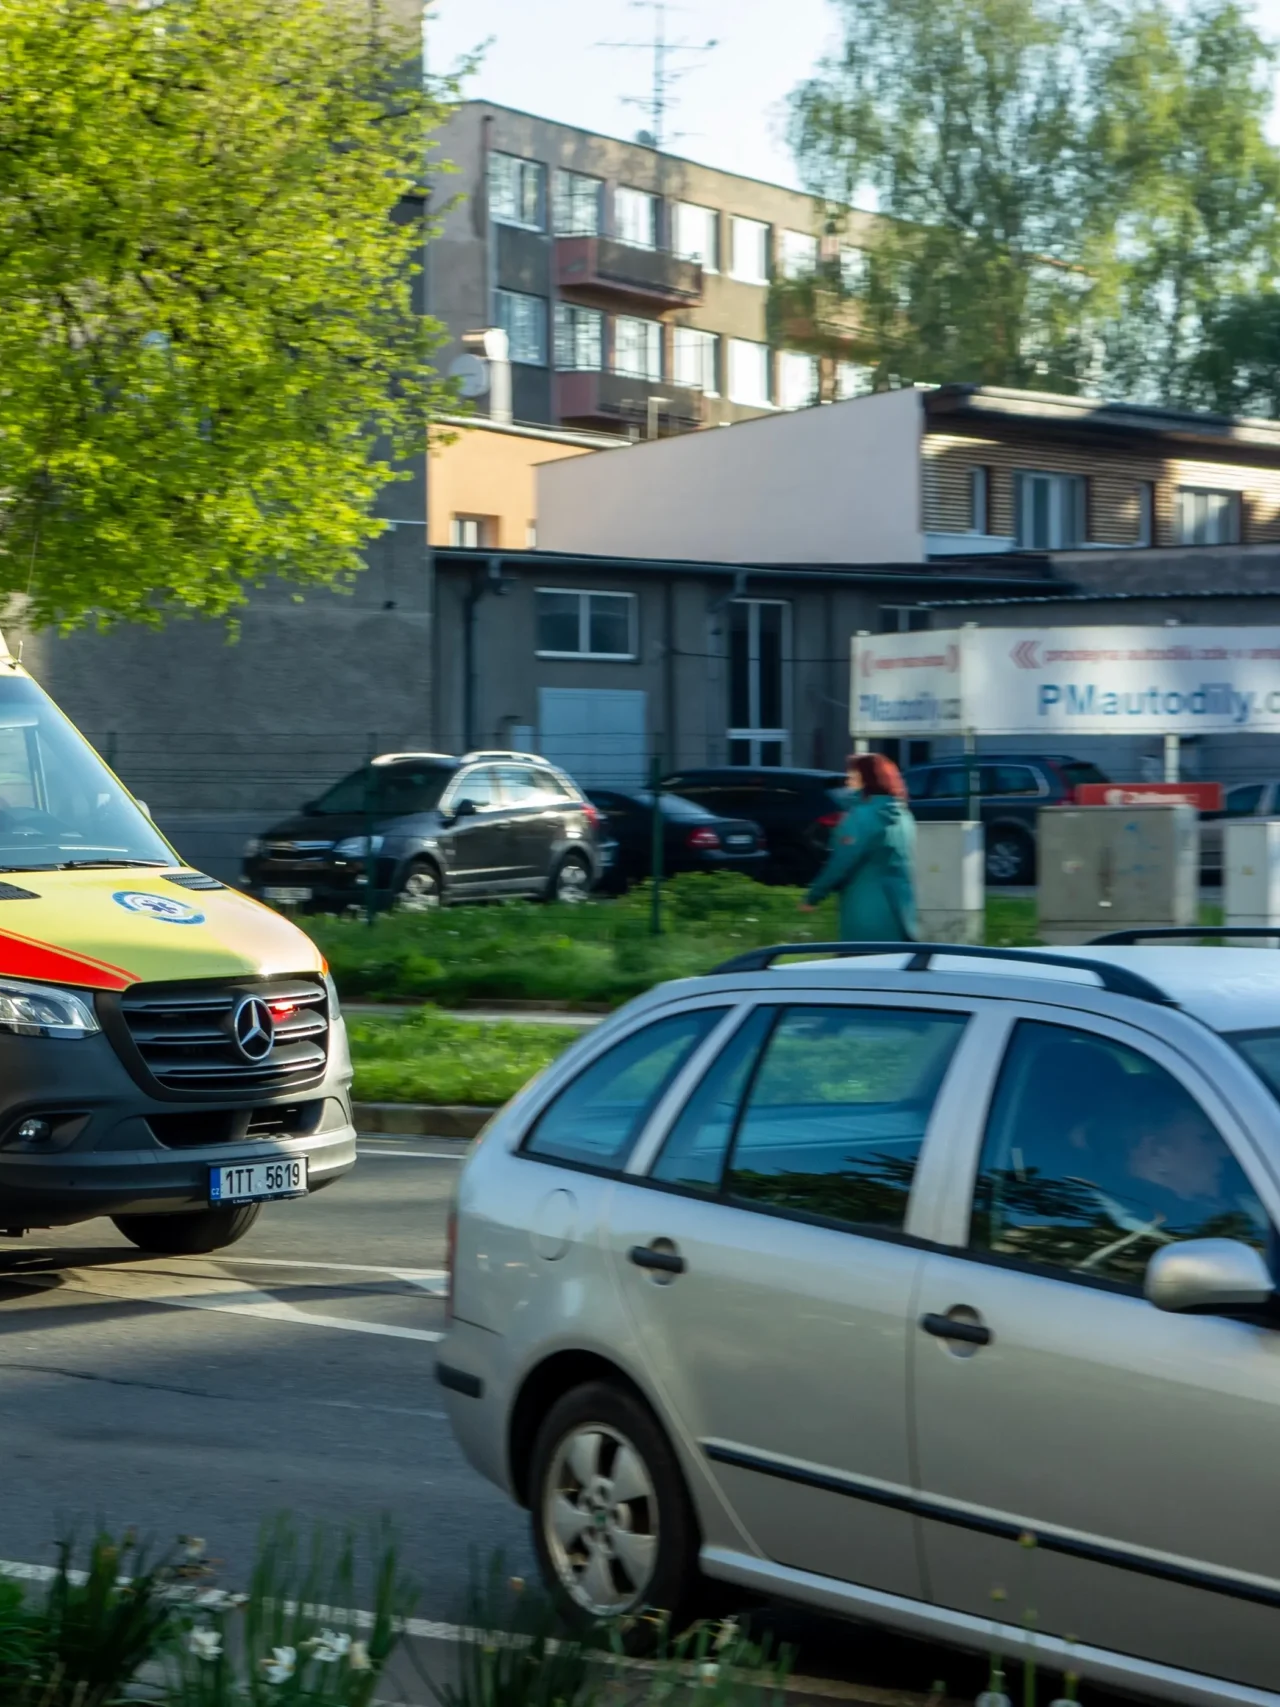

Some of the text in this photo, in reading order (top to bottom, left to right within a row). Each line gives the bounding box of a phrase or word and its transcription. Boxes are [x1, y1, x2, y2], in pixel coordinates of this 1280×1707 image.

[211, 1163, 300, 1196] CZ 1TT 5619
